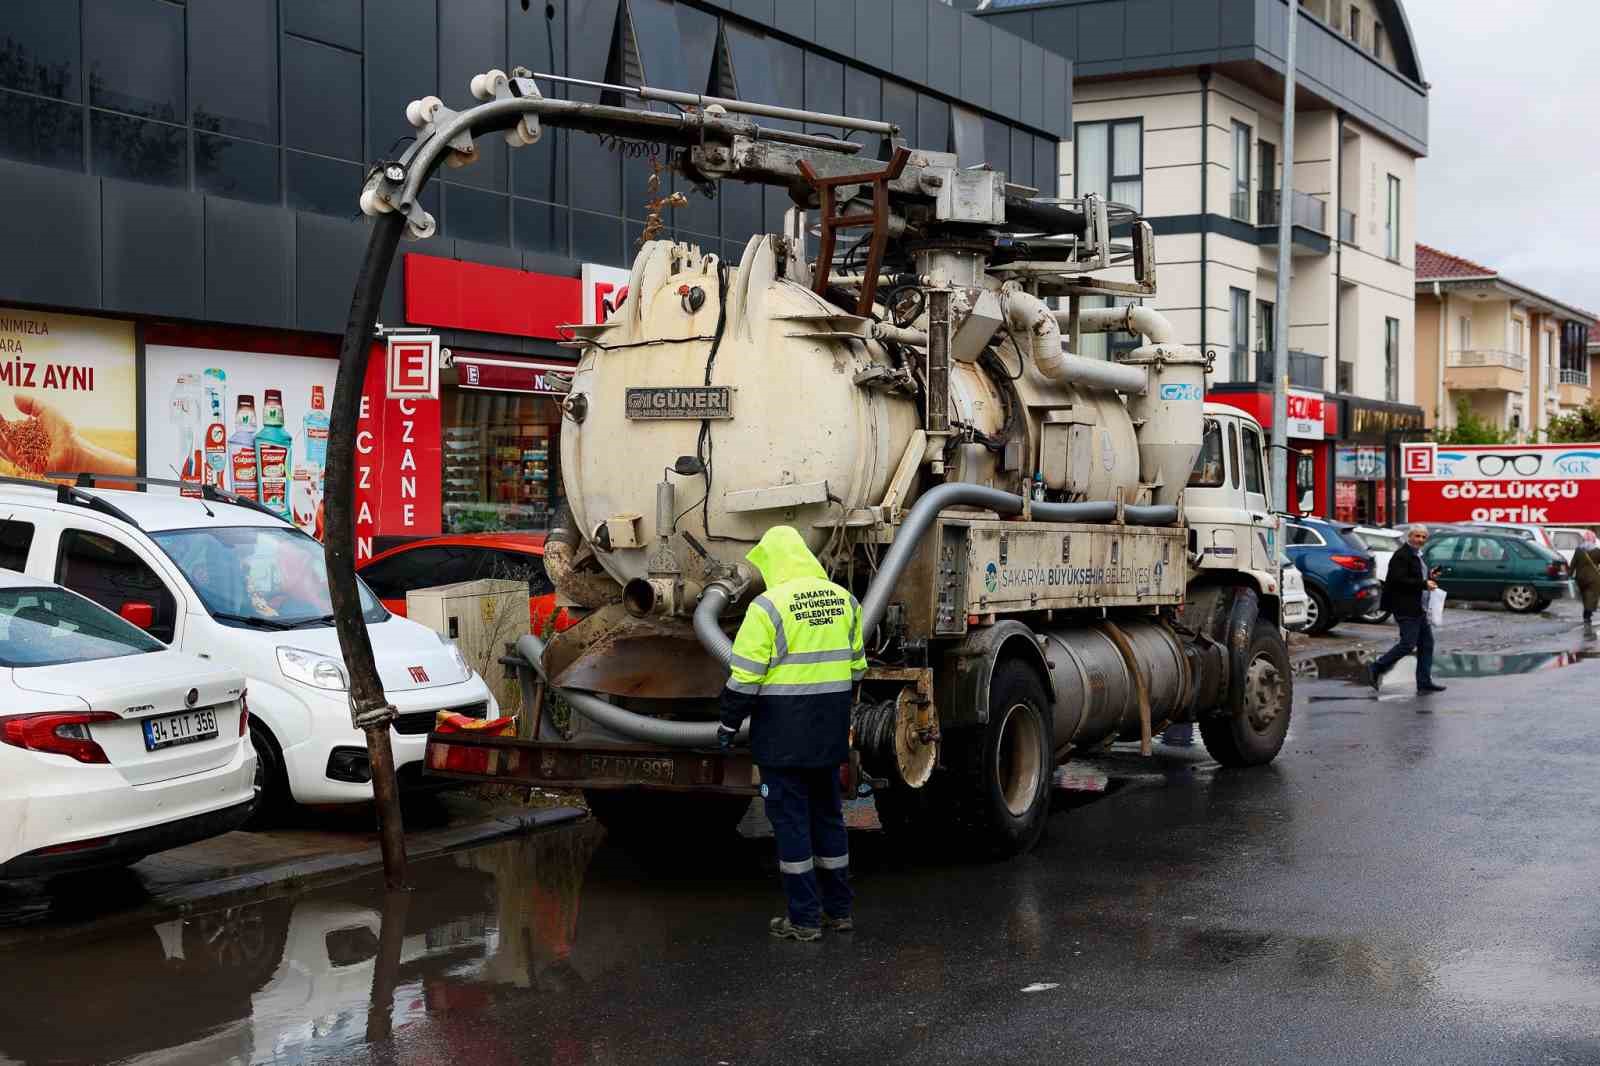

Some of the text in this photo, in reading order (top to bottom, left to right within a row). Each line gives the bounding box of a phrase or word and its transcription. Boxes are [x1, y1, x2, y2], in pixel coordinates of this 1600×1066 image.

[43, 364, 94, 391] AYNI
[653, 388, 728, 409] GÜNERİ
[1559, 462, 1591, 474] SGK
[1441, 481, 1579, 502] GÖZLÜKÇÜ
[1471, 505, 1549, 522] OPTİK
[1002, 567, 1046, 588] SAKARYA
[793, 590, 836, 600] SAKARYA
[407, 666, 430, 683] FIAT
[152, 711, 215, 740] 34 EIT 356
